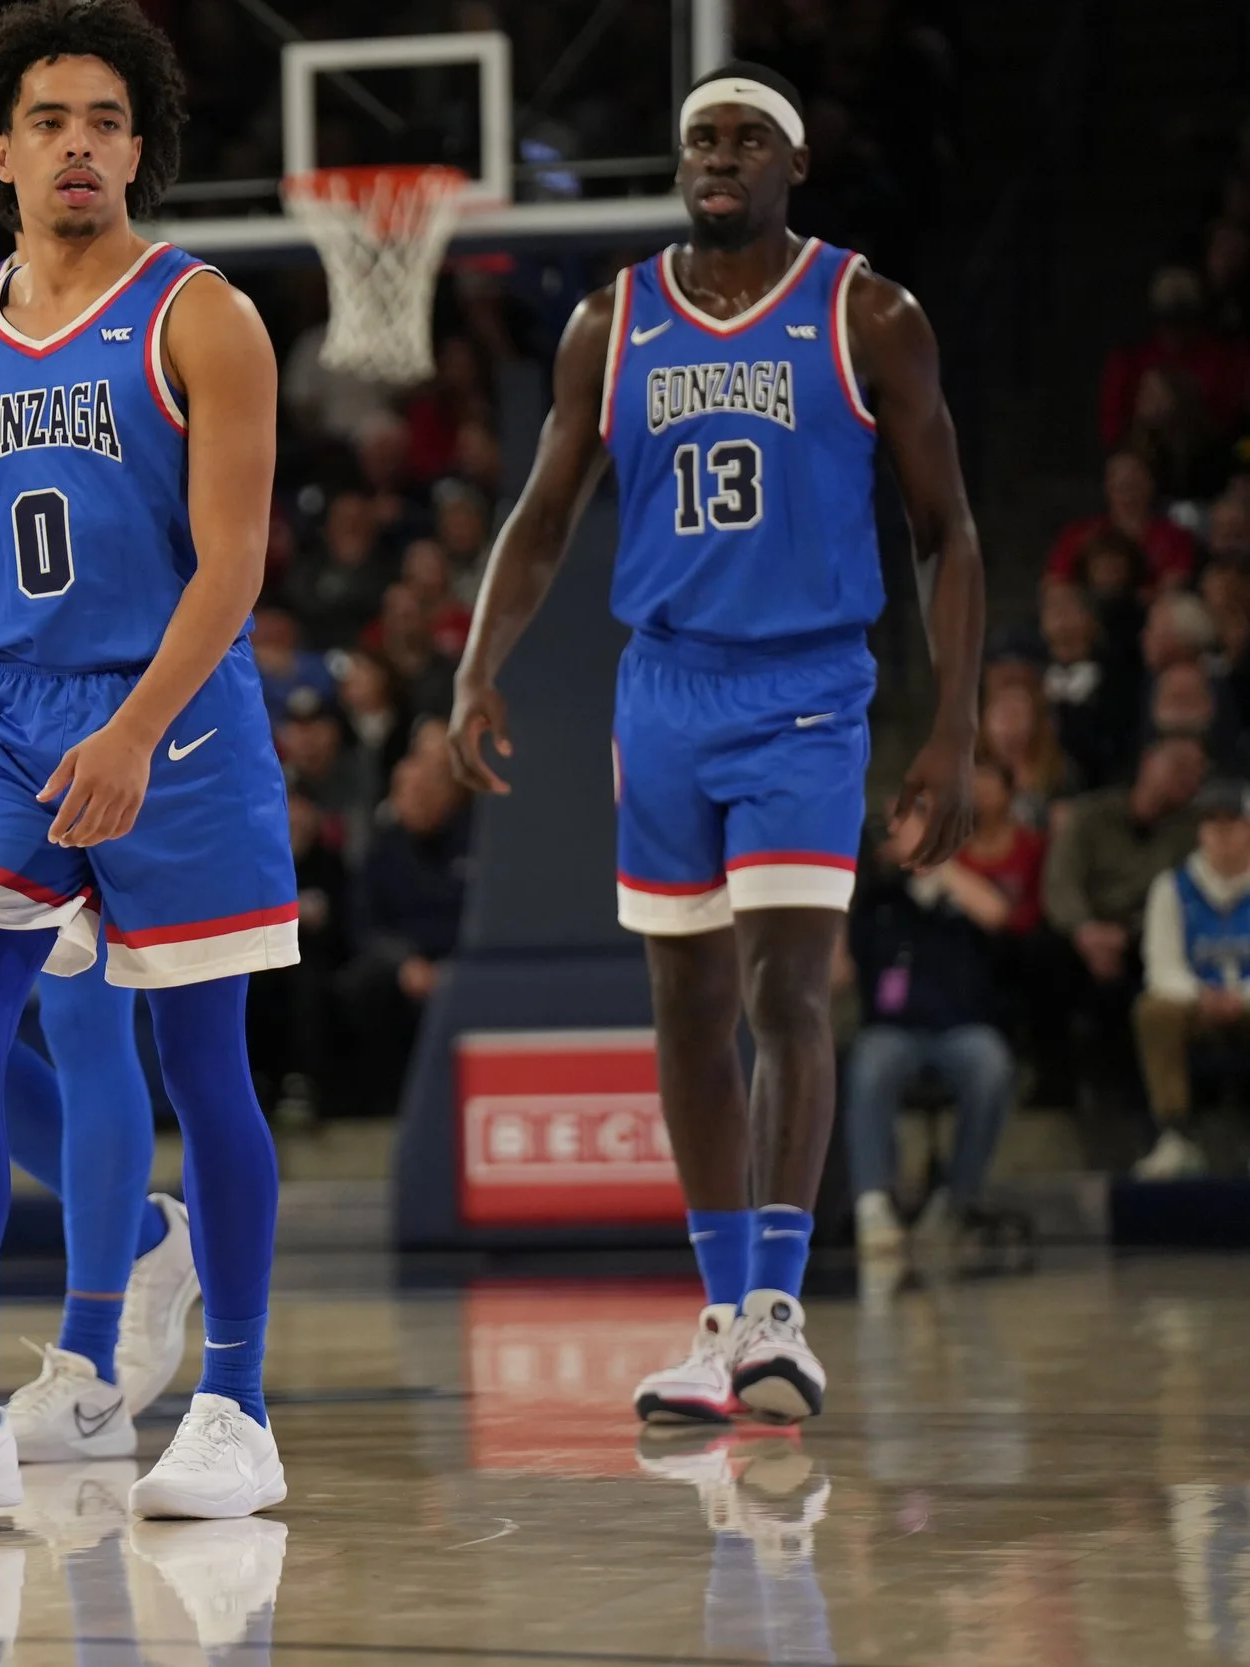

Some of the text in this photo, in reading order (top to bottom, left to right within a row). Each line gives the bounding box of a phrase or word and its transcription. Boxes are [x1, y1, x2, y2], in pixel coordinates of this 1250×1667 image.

[101, 327, 133, 341] WCC
[648, 361, 795, 435] GONZAGA
[674, 439, 762, 534] 13
[11, 487, 75, 598] 0
